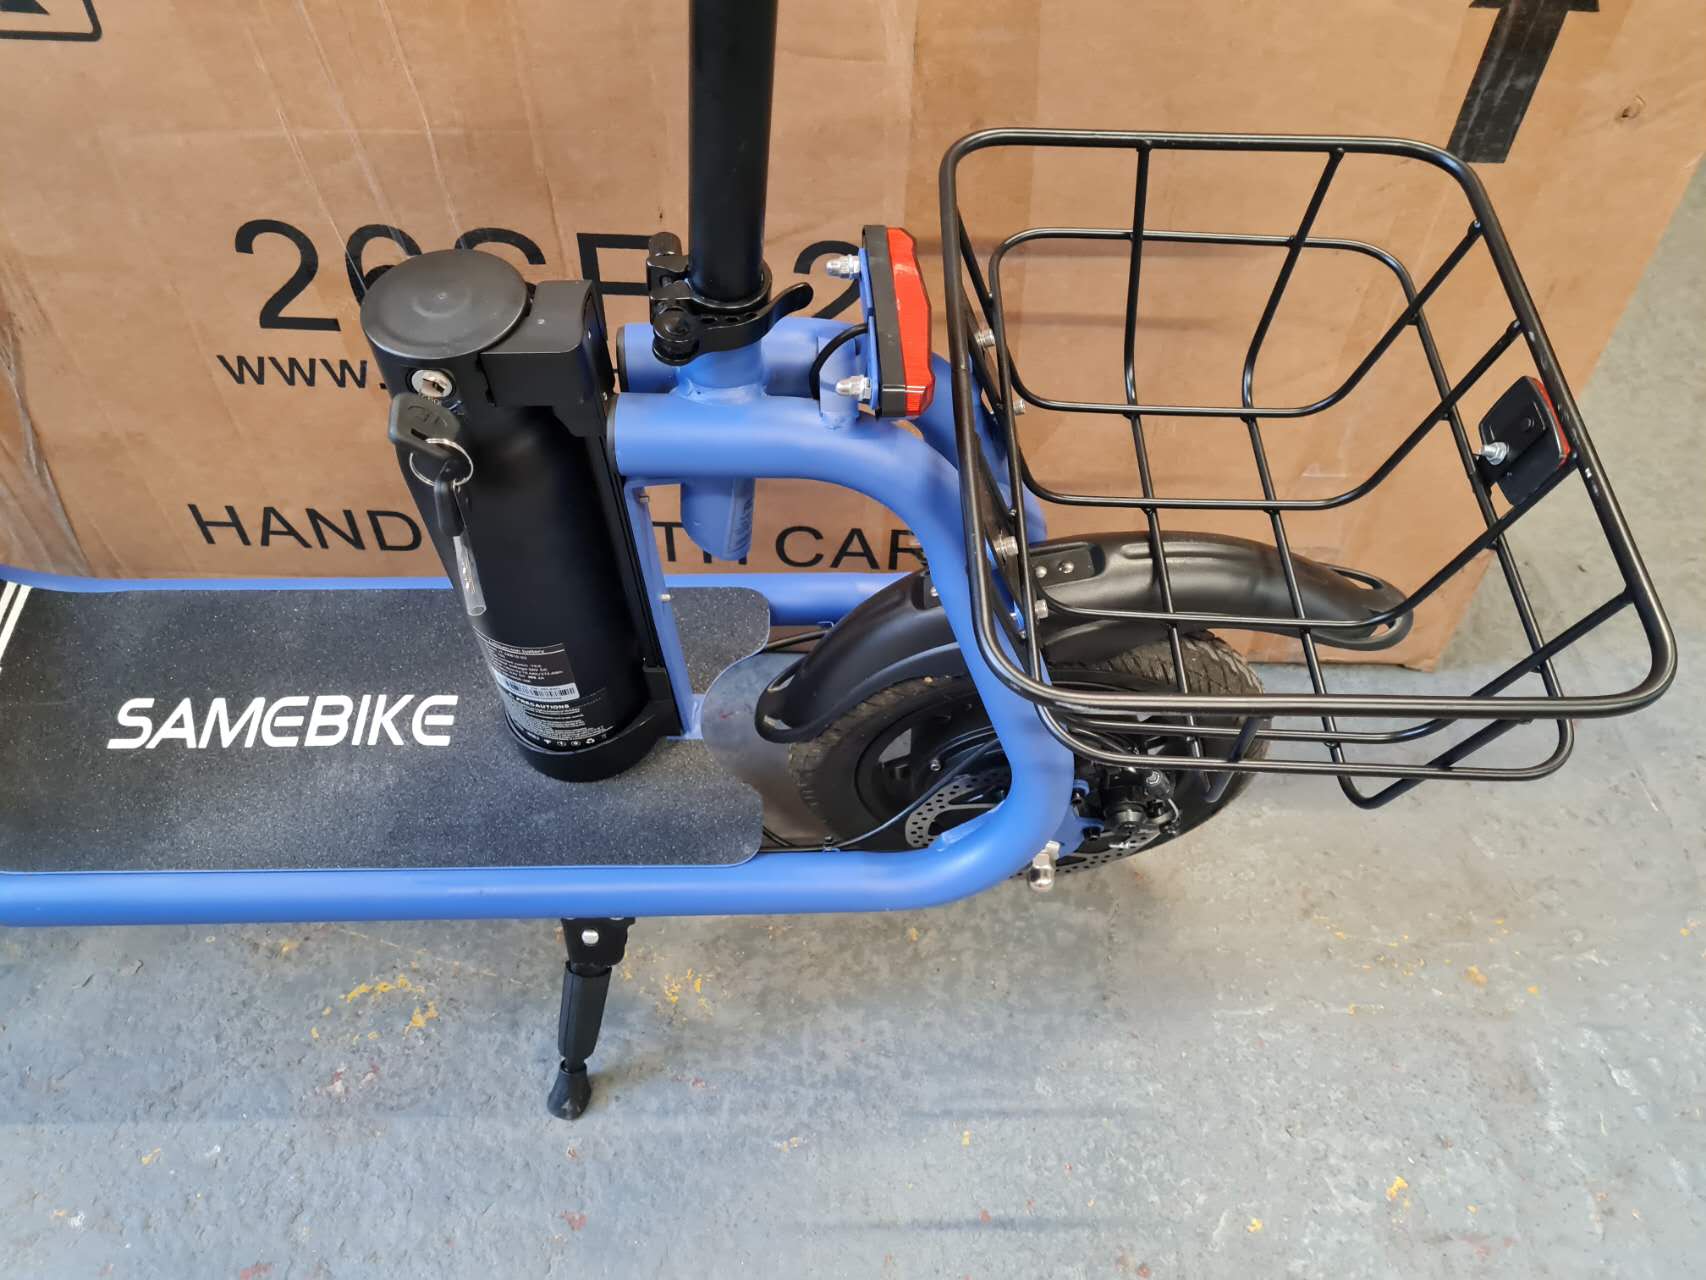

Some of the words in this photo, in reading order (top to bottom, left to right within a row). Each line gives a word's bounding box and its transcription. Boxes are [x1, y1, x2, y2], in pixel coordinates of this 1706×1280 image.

[187, 503, 423, 552] HAND
[775, 525, 930, 571] CAR
[106, 694, 458, 749] SAMEBIKE
